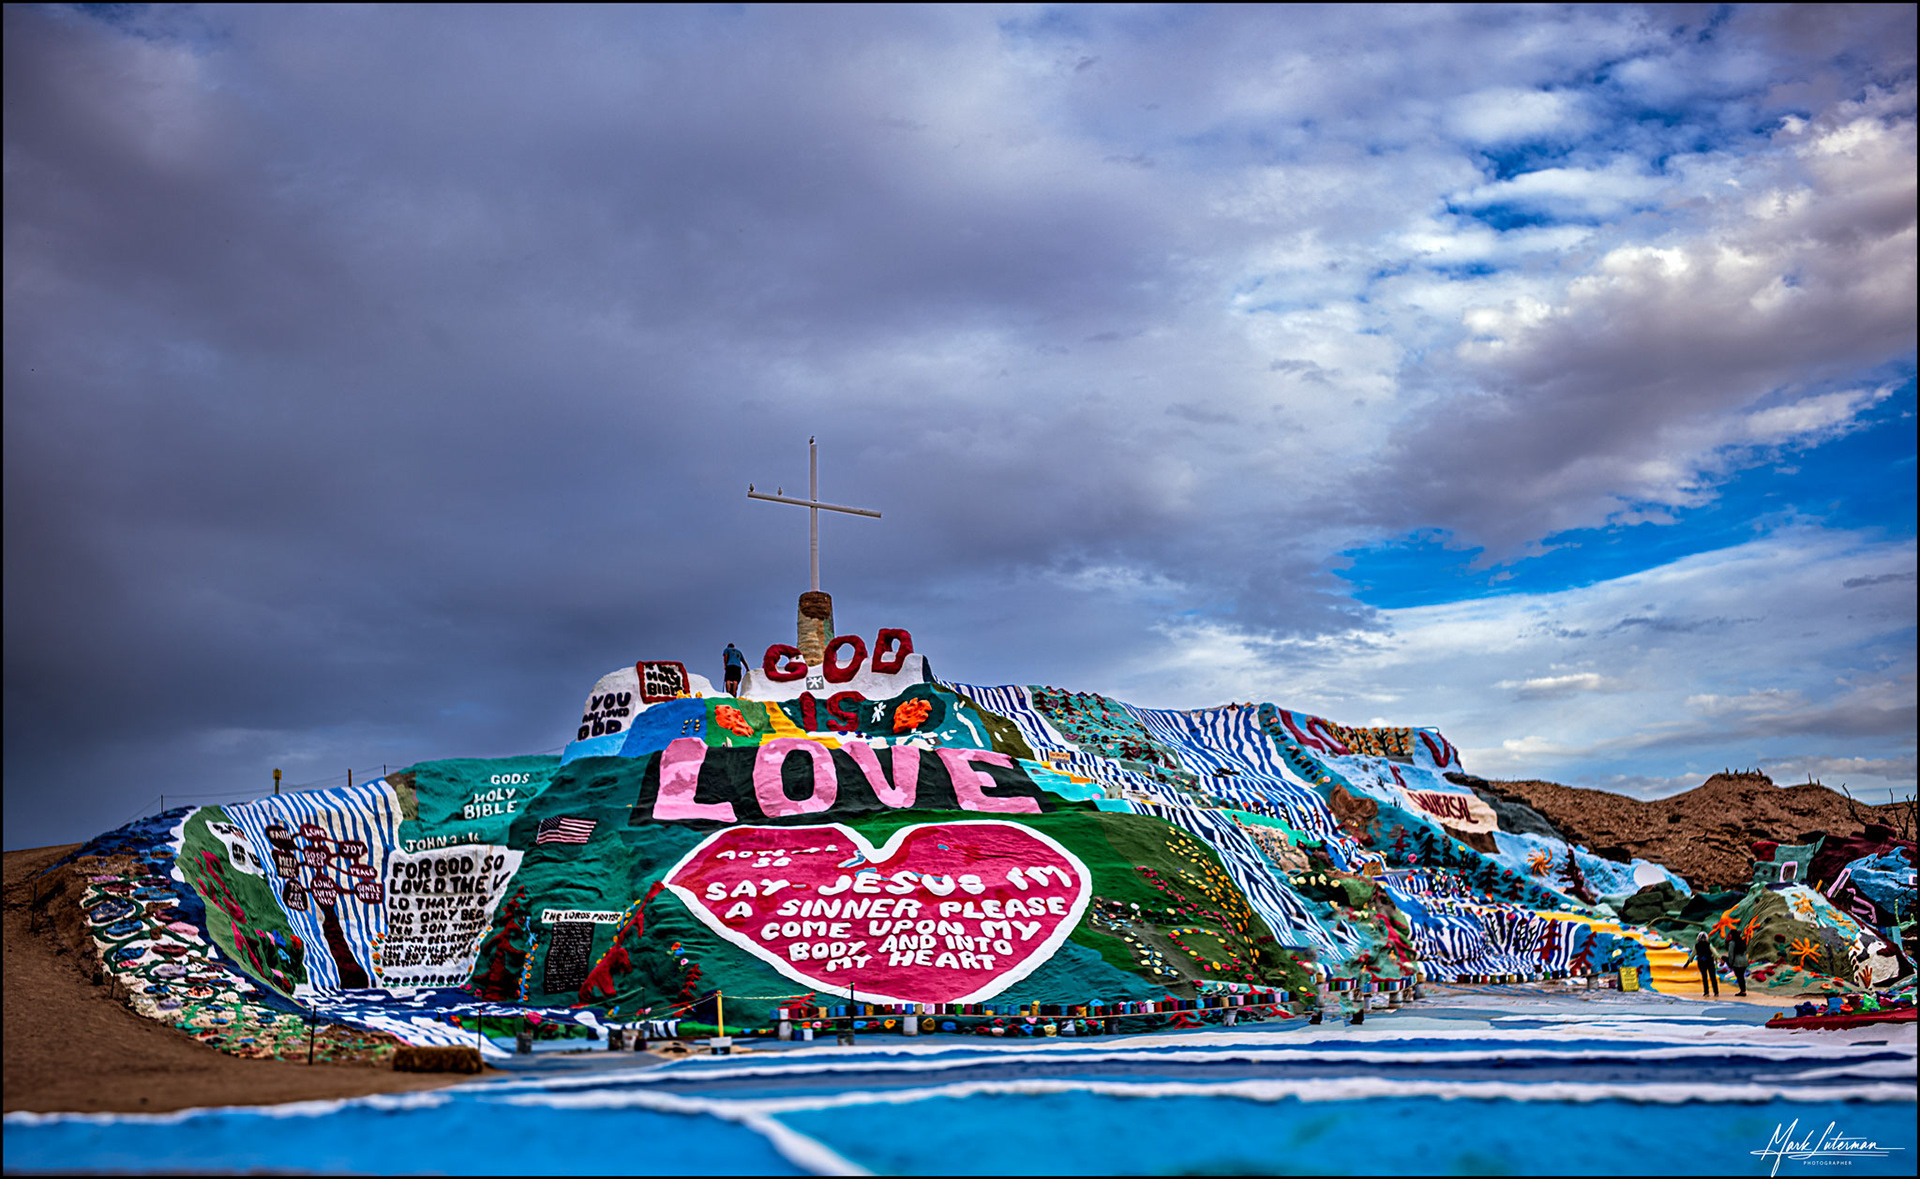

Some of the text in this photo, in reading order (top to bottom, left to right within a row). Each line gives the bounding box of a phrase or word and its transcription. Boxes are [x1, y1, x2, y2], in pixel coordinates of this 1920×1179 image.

[763, 628, 913, 683] GOD
[591, 692, 631, 711] YOU
[800, 691, 867, 732] IS
[490, 773, 530, 784] GODS
[652, 737, 1043, 823] LOVE
[473, 788, 516, 803] HOLY
[463, 801, 517, 819] BIBLE
[269, 829, 291, 840] FAITH
[304, 827, 326, 838] LOVE
[343, 843, 363, 856] JOY
[404, 835, 446, 852] JOHN
[305, 850, 326, 860] GOOD
[350, 867, 375, 877] PEACE
[393, 855, 505, 879] FOR GOD SO
[313, 879, 334, 889] LONG
[357, 884, 381, 893] GENTLE
[390, 879, 446, 894] LOVED
[450, 876, 488, 894] THE
[818, 870, 986, 897] JESUS
[359, 892, 380, 900] NESS
[415, 895, 454, 910] THAT
[456, 895, 474, 906] HE
[725, 896, 1068, 919] A SINNER PLEASE
[389, 912, 414, 924] HIS
[420, 909, 458, 923] ONLY
[544, 911, 562, 921] THE
[420, 923, 447, 935] SON
[760, 919, 1042, 941] COME UPON MY
[406, 944, 447, 954] SHOULD
[788, 934, 1013, 961] BODY AND INTO
[405, 952, 426, 960] BUT
[826, 950, 996, 972] MY HEART
